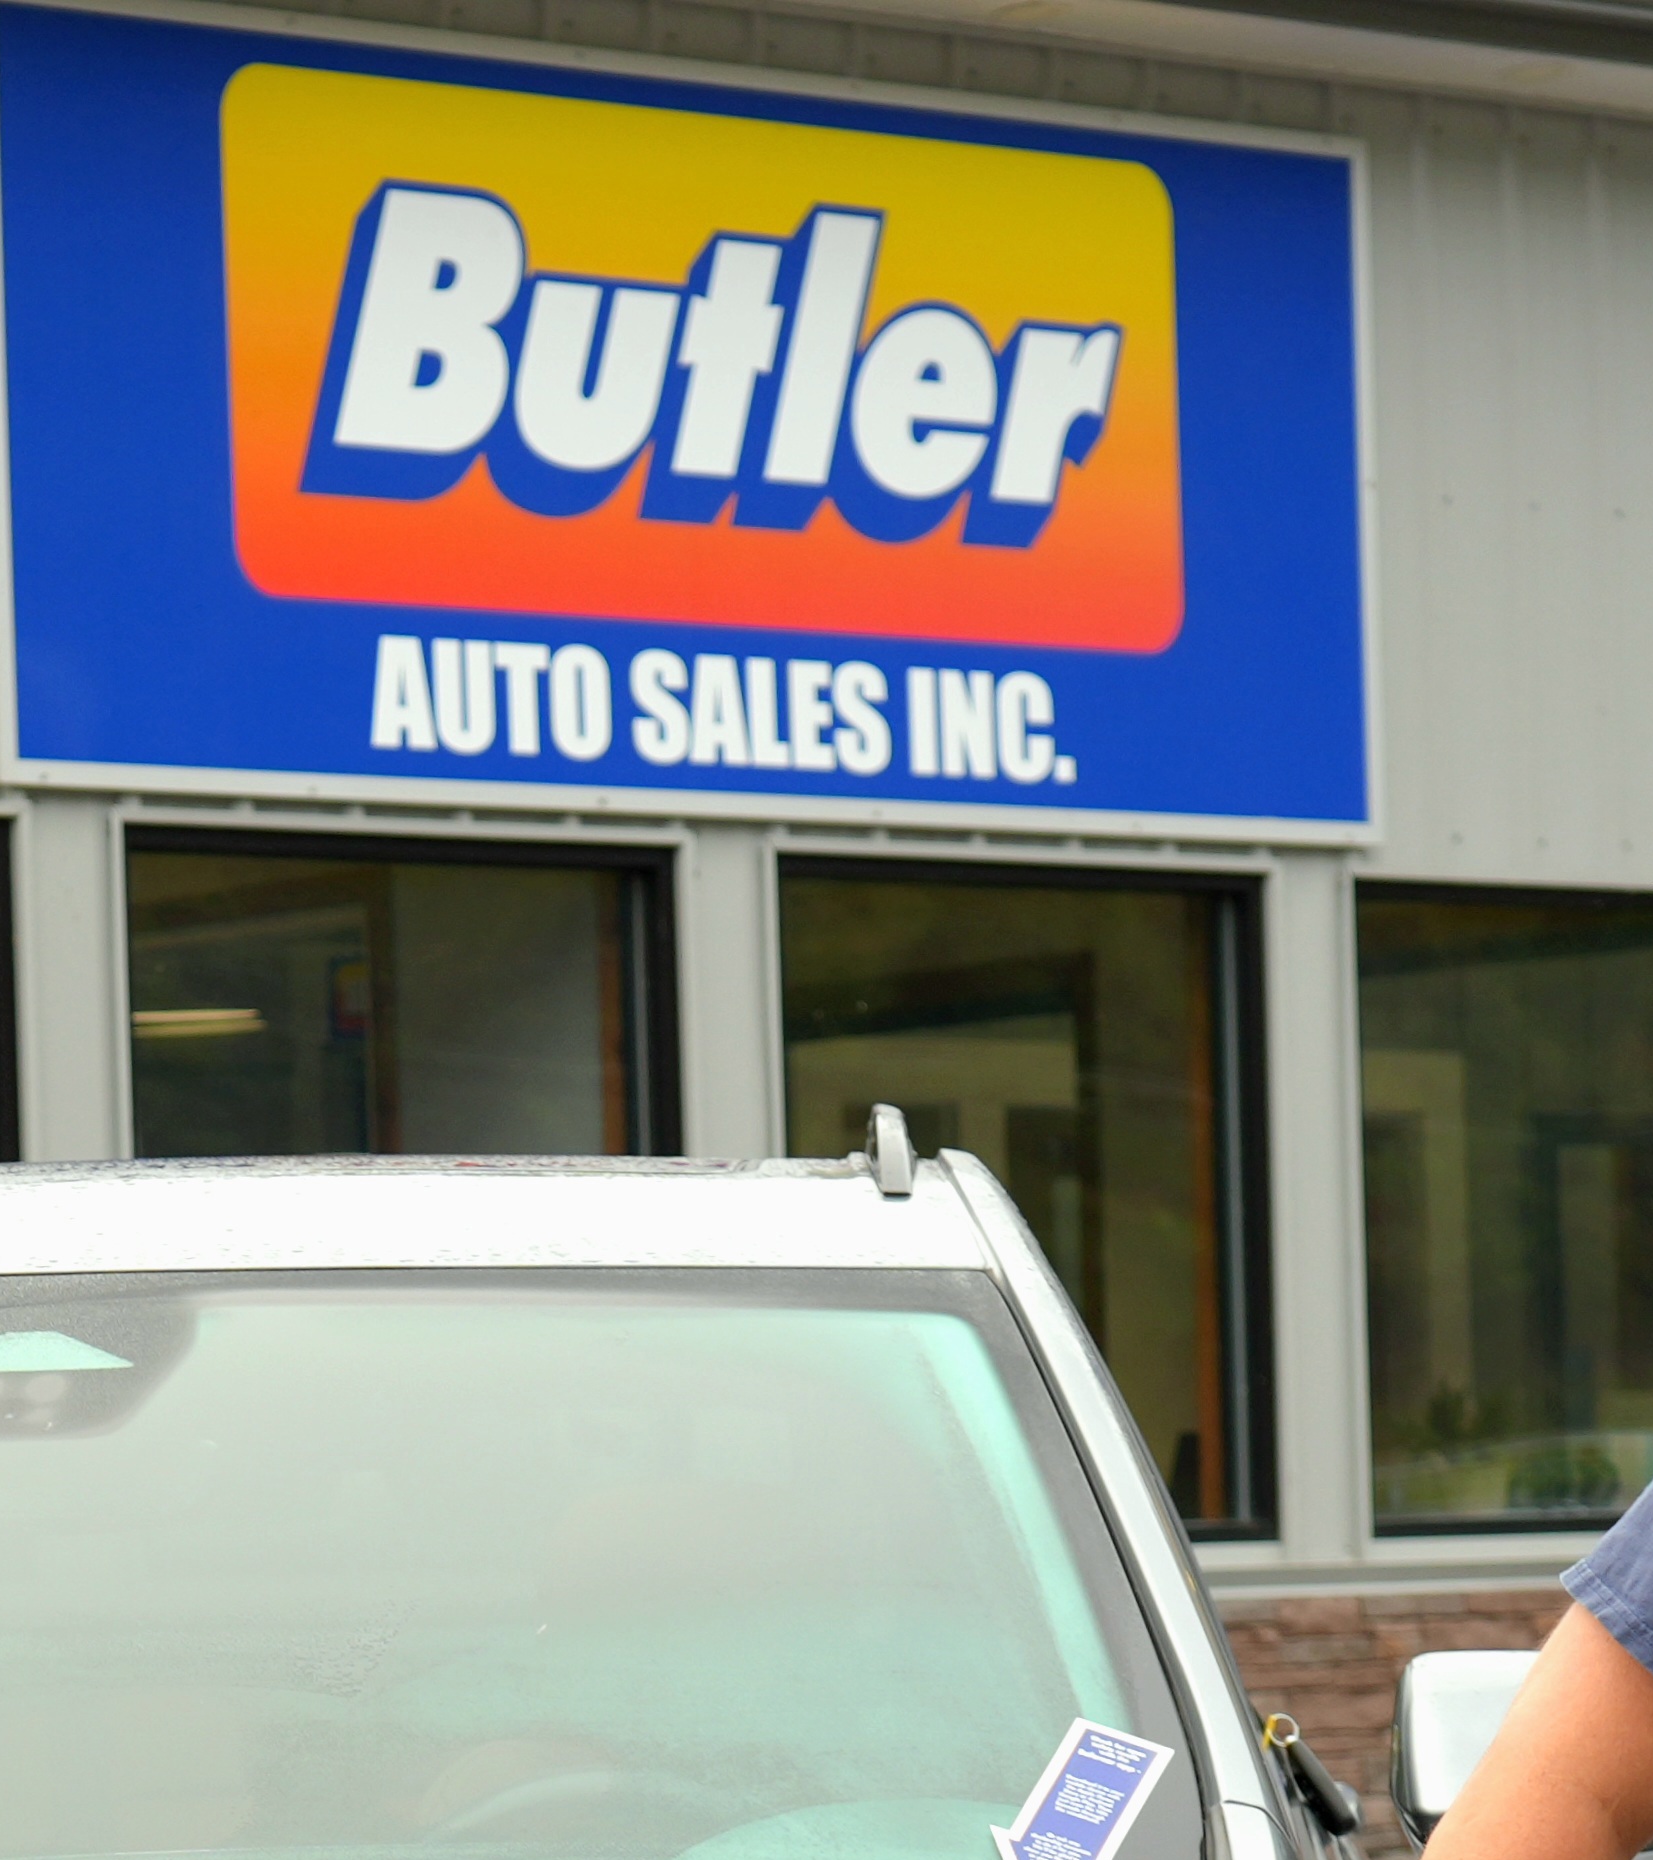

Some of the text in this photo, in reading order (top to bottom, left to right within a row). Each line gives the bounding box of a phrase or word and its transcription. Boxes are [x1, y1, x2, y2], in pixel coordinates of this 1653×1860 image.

[302, 179, 1122, 546] Butler
[369, 633, 1078, 784] AUTO SALES INC.
